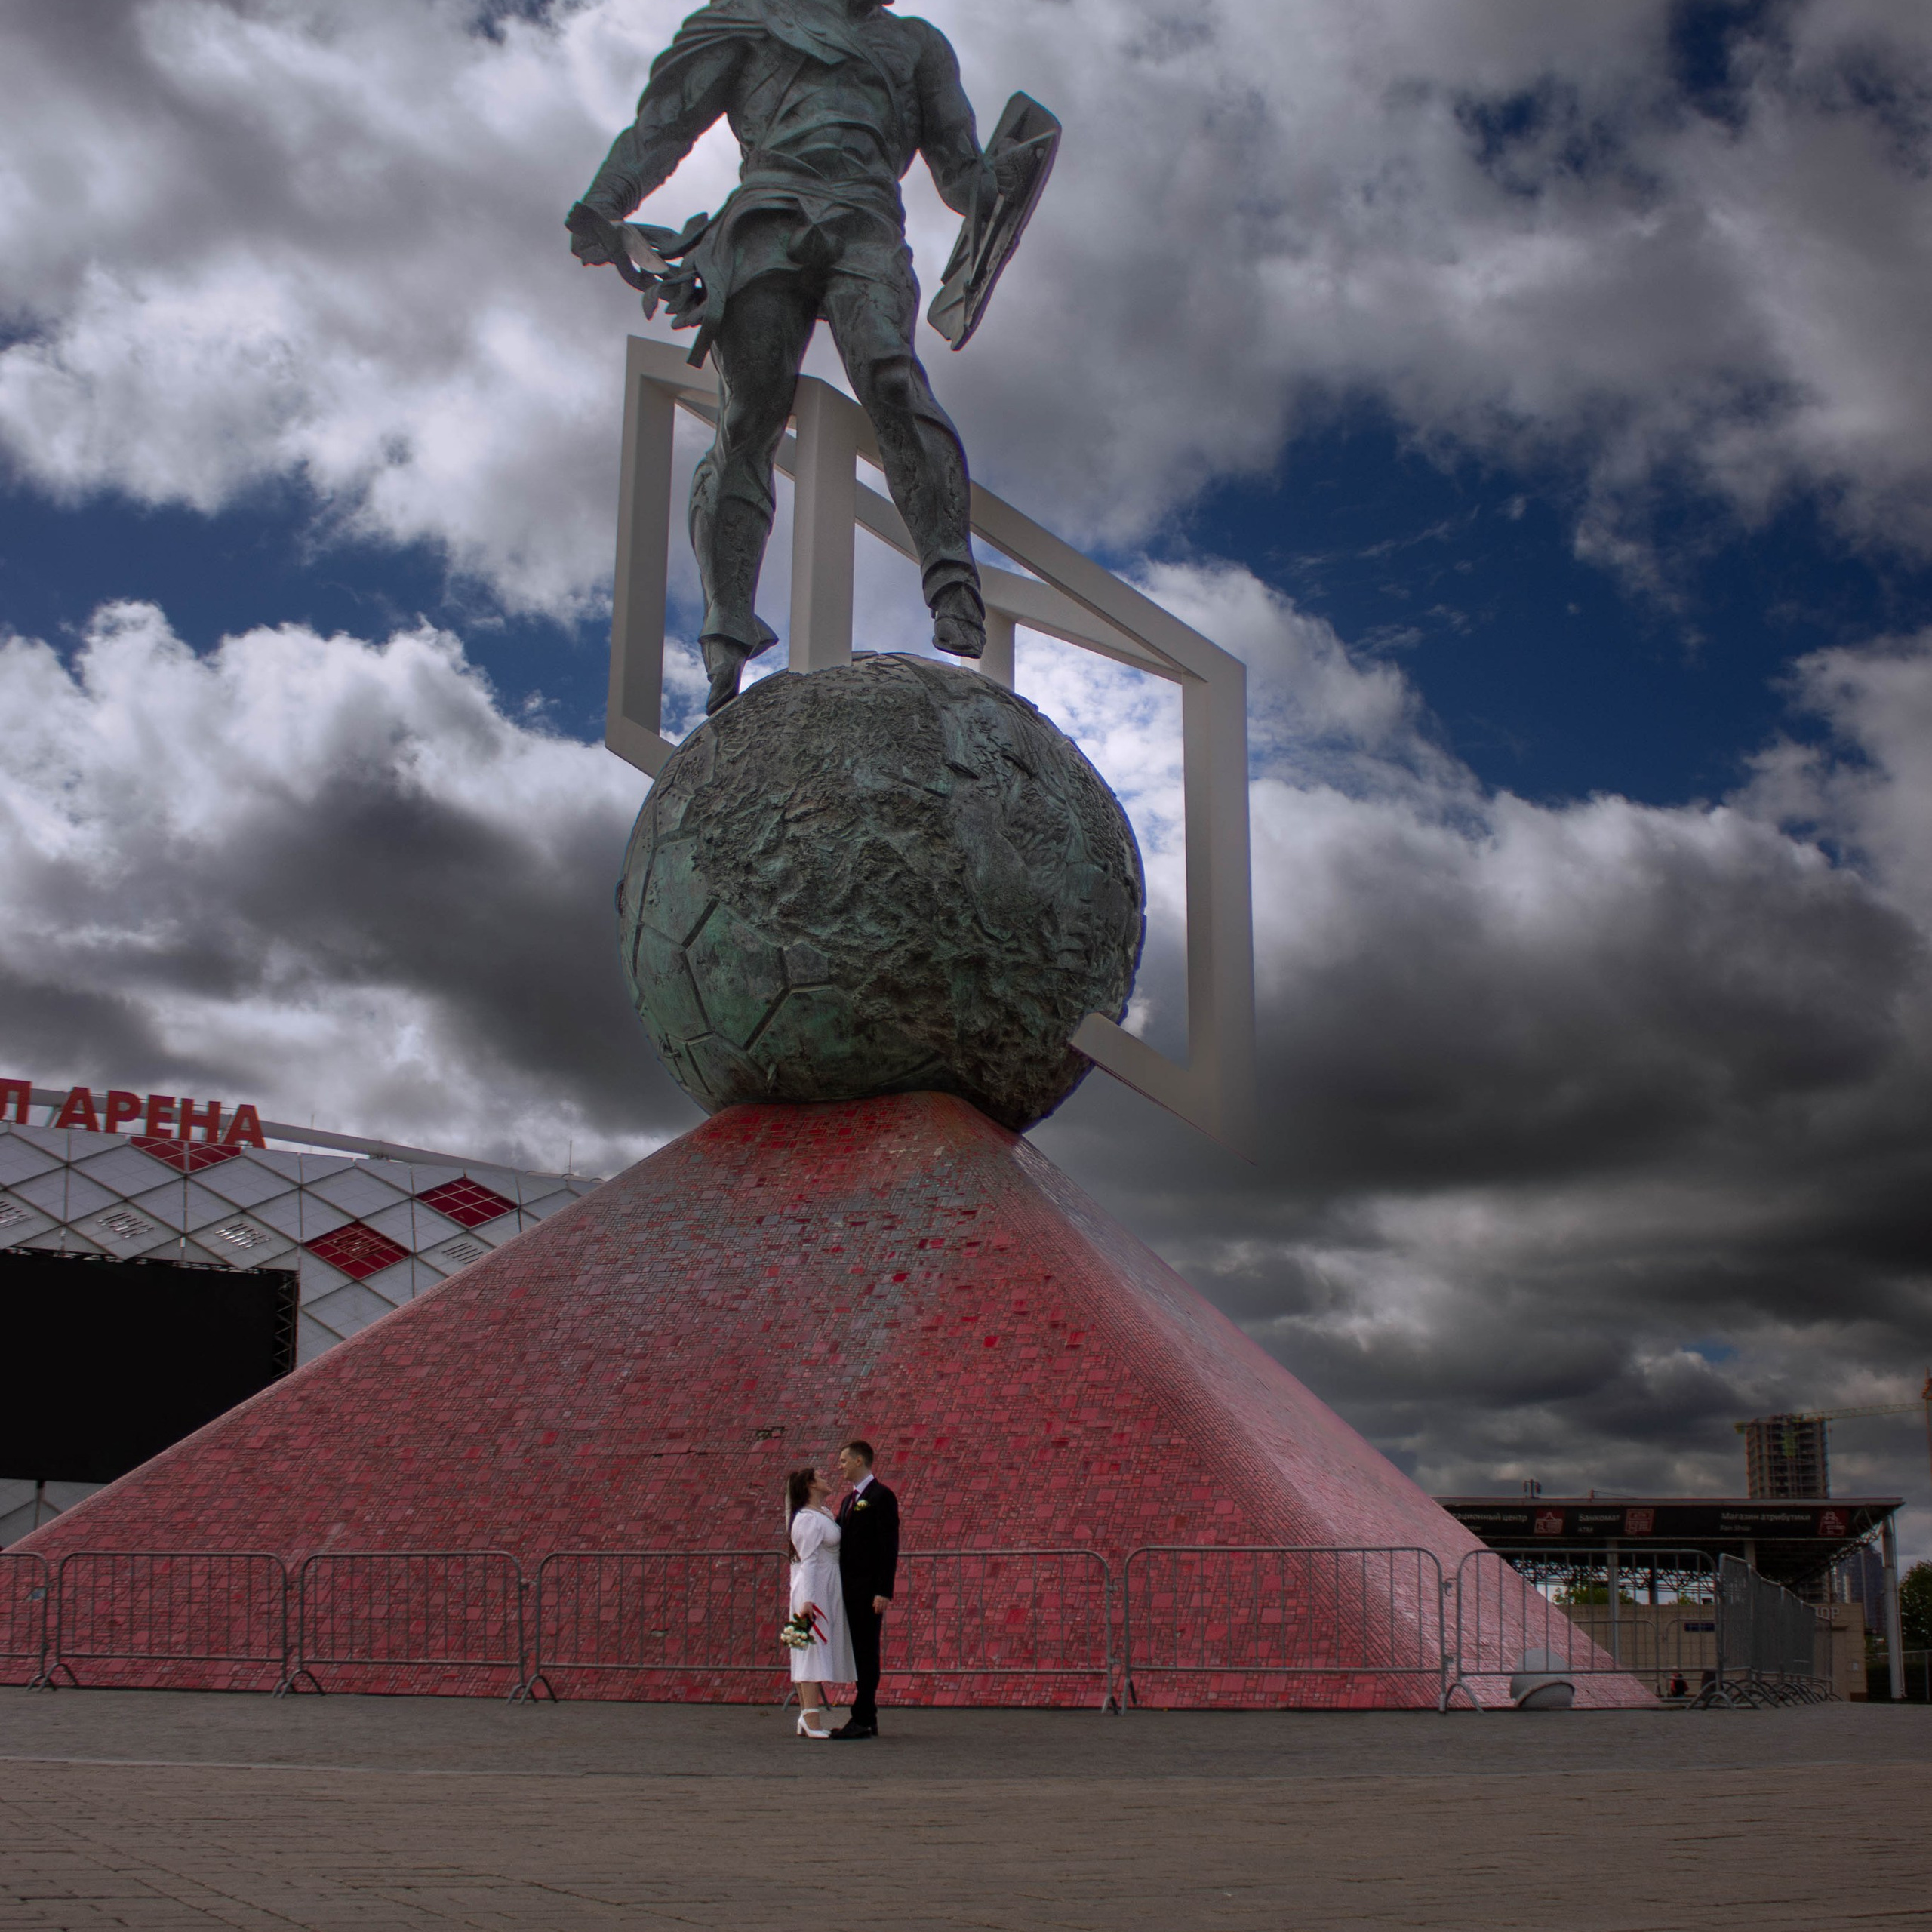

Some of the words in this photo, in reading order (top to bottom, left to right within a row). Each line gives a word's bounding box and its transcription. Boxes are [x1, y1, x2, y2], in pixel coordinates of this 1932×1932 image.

[55, 1086, 266, 1149] АРЕНА
[1502, 1514, 1527, 1523] центр
[1578, 1513, 1620, 1521] Банкомат
[1721, 1512, 1758, 1521] Магазин
[1760, 1512, 1811, 1522] атрибутики
